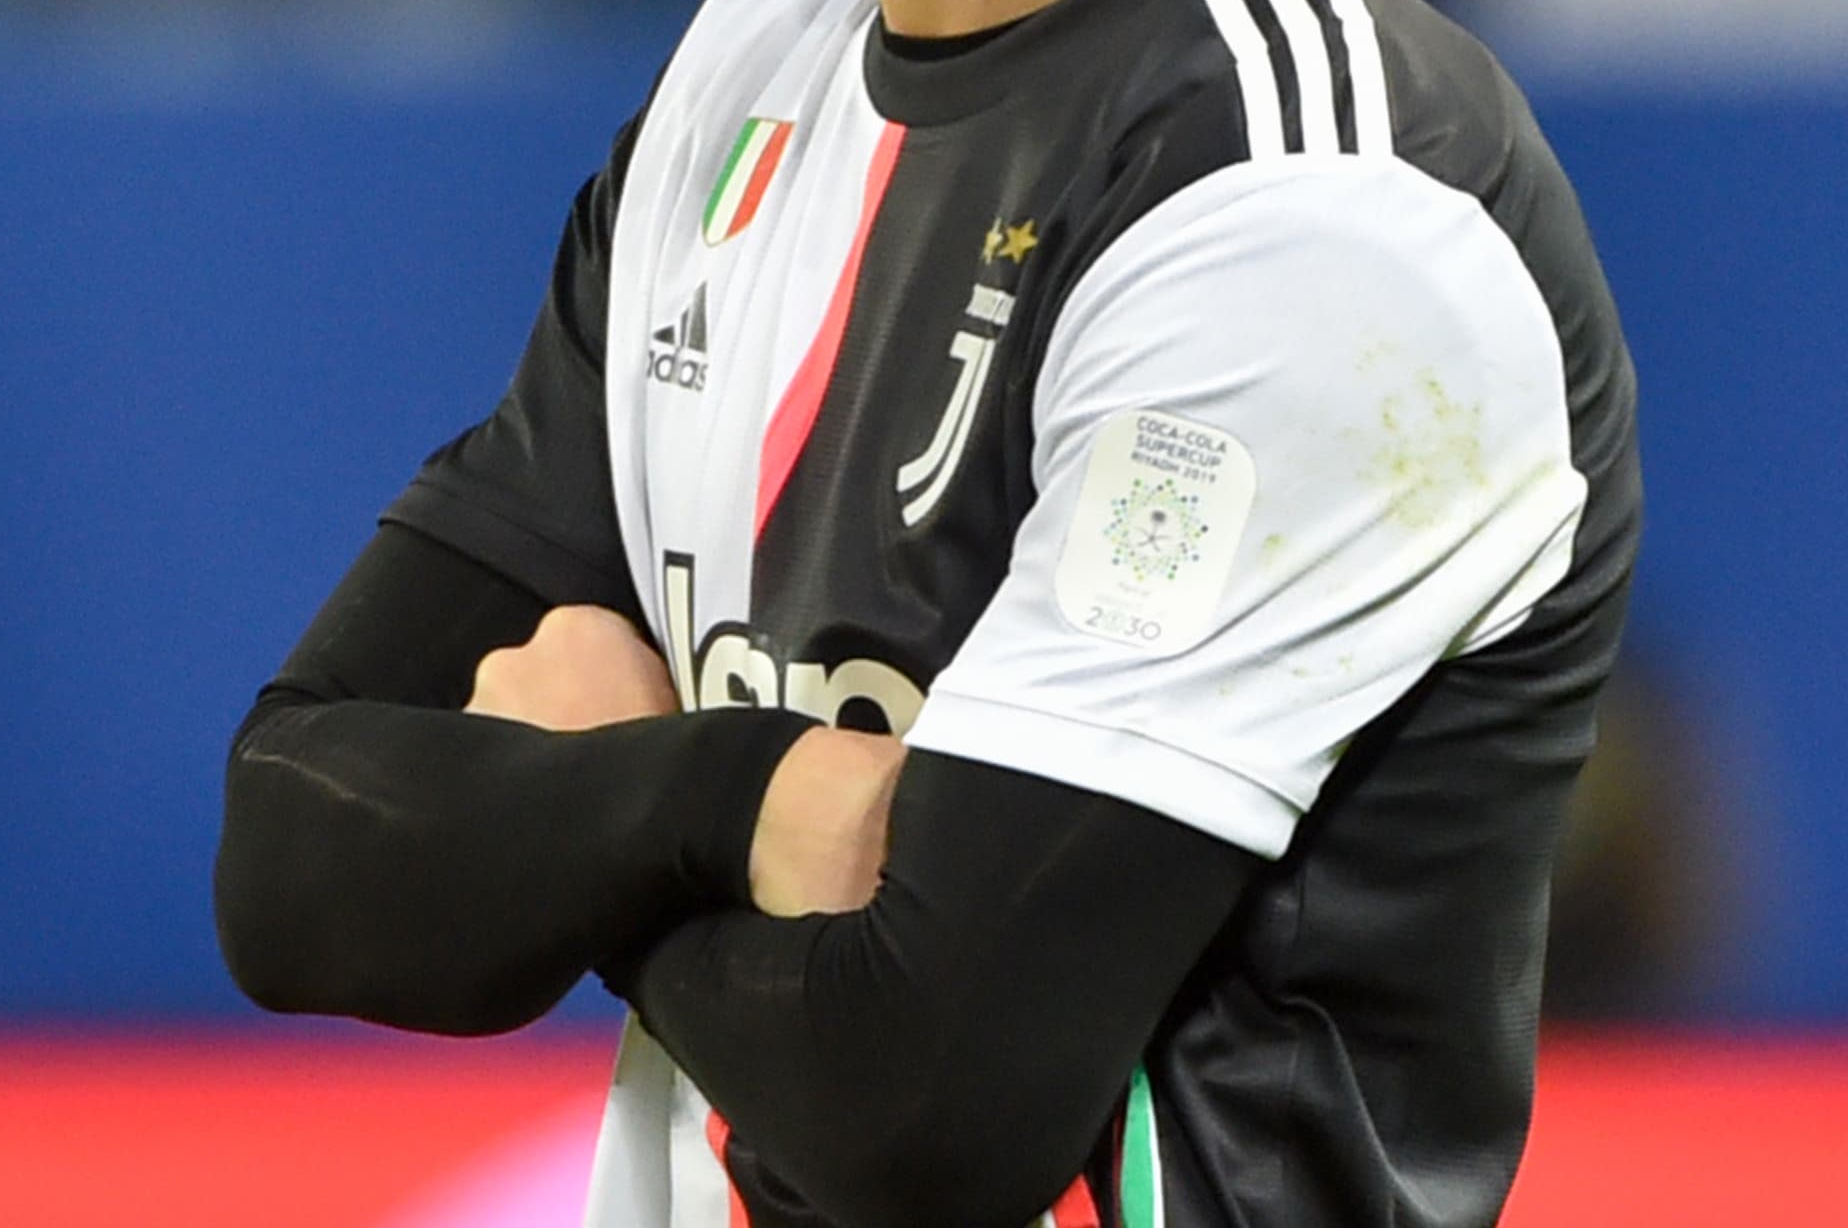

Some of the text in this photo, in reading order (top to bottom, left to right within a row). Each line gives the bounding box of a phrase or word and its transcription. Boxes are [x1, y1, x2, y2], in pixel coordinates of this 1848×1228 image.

[1136, 415, 1227, 454] COCA-COLA
[1136, 433, 1222, 468] SUPERCUP
[1130, 450, 1217, 485] RIYADH 2019
